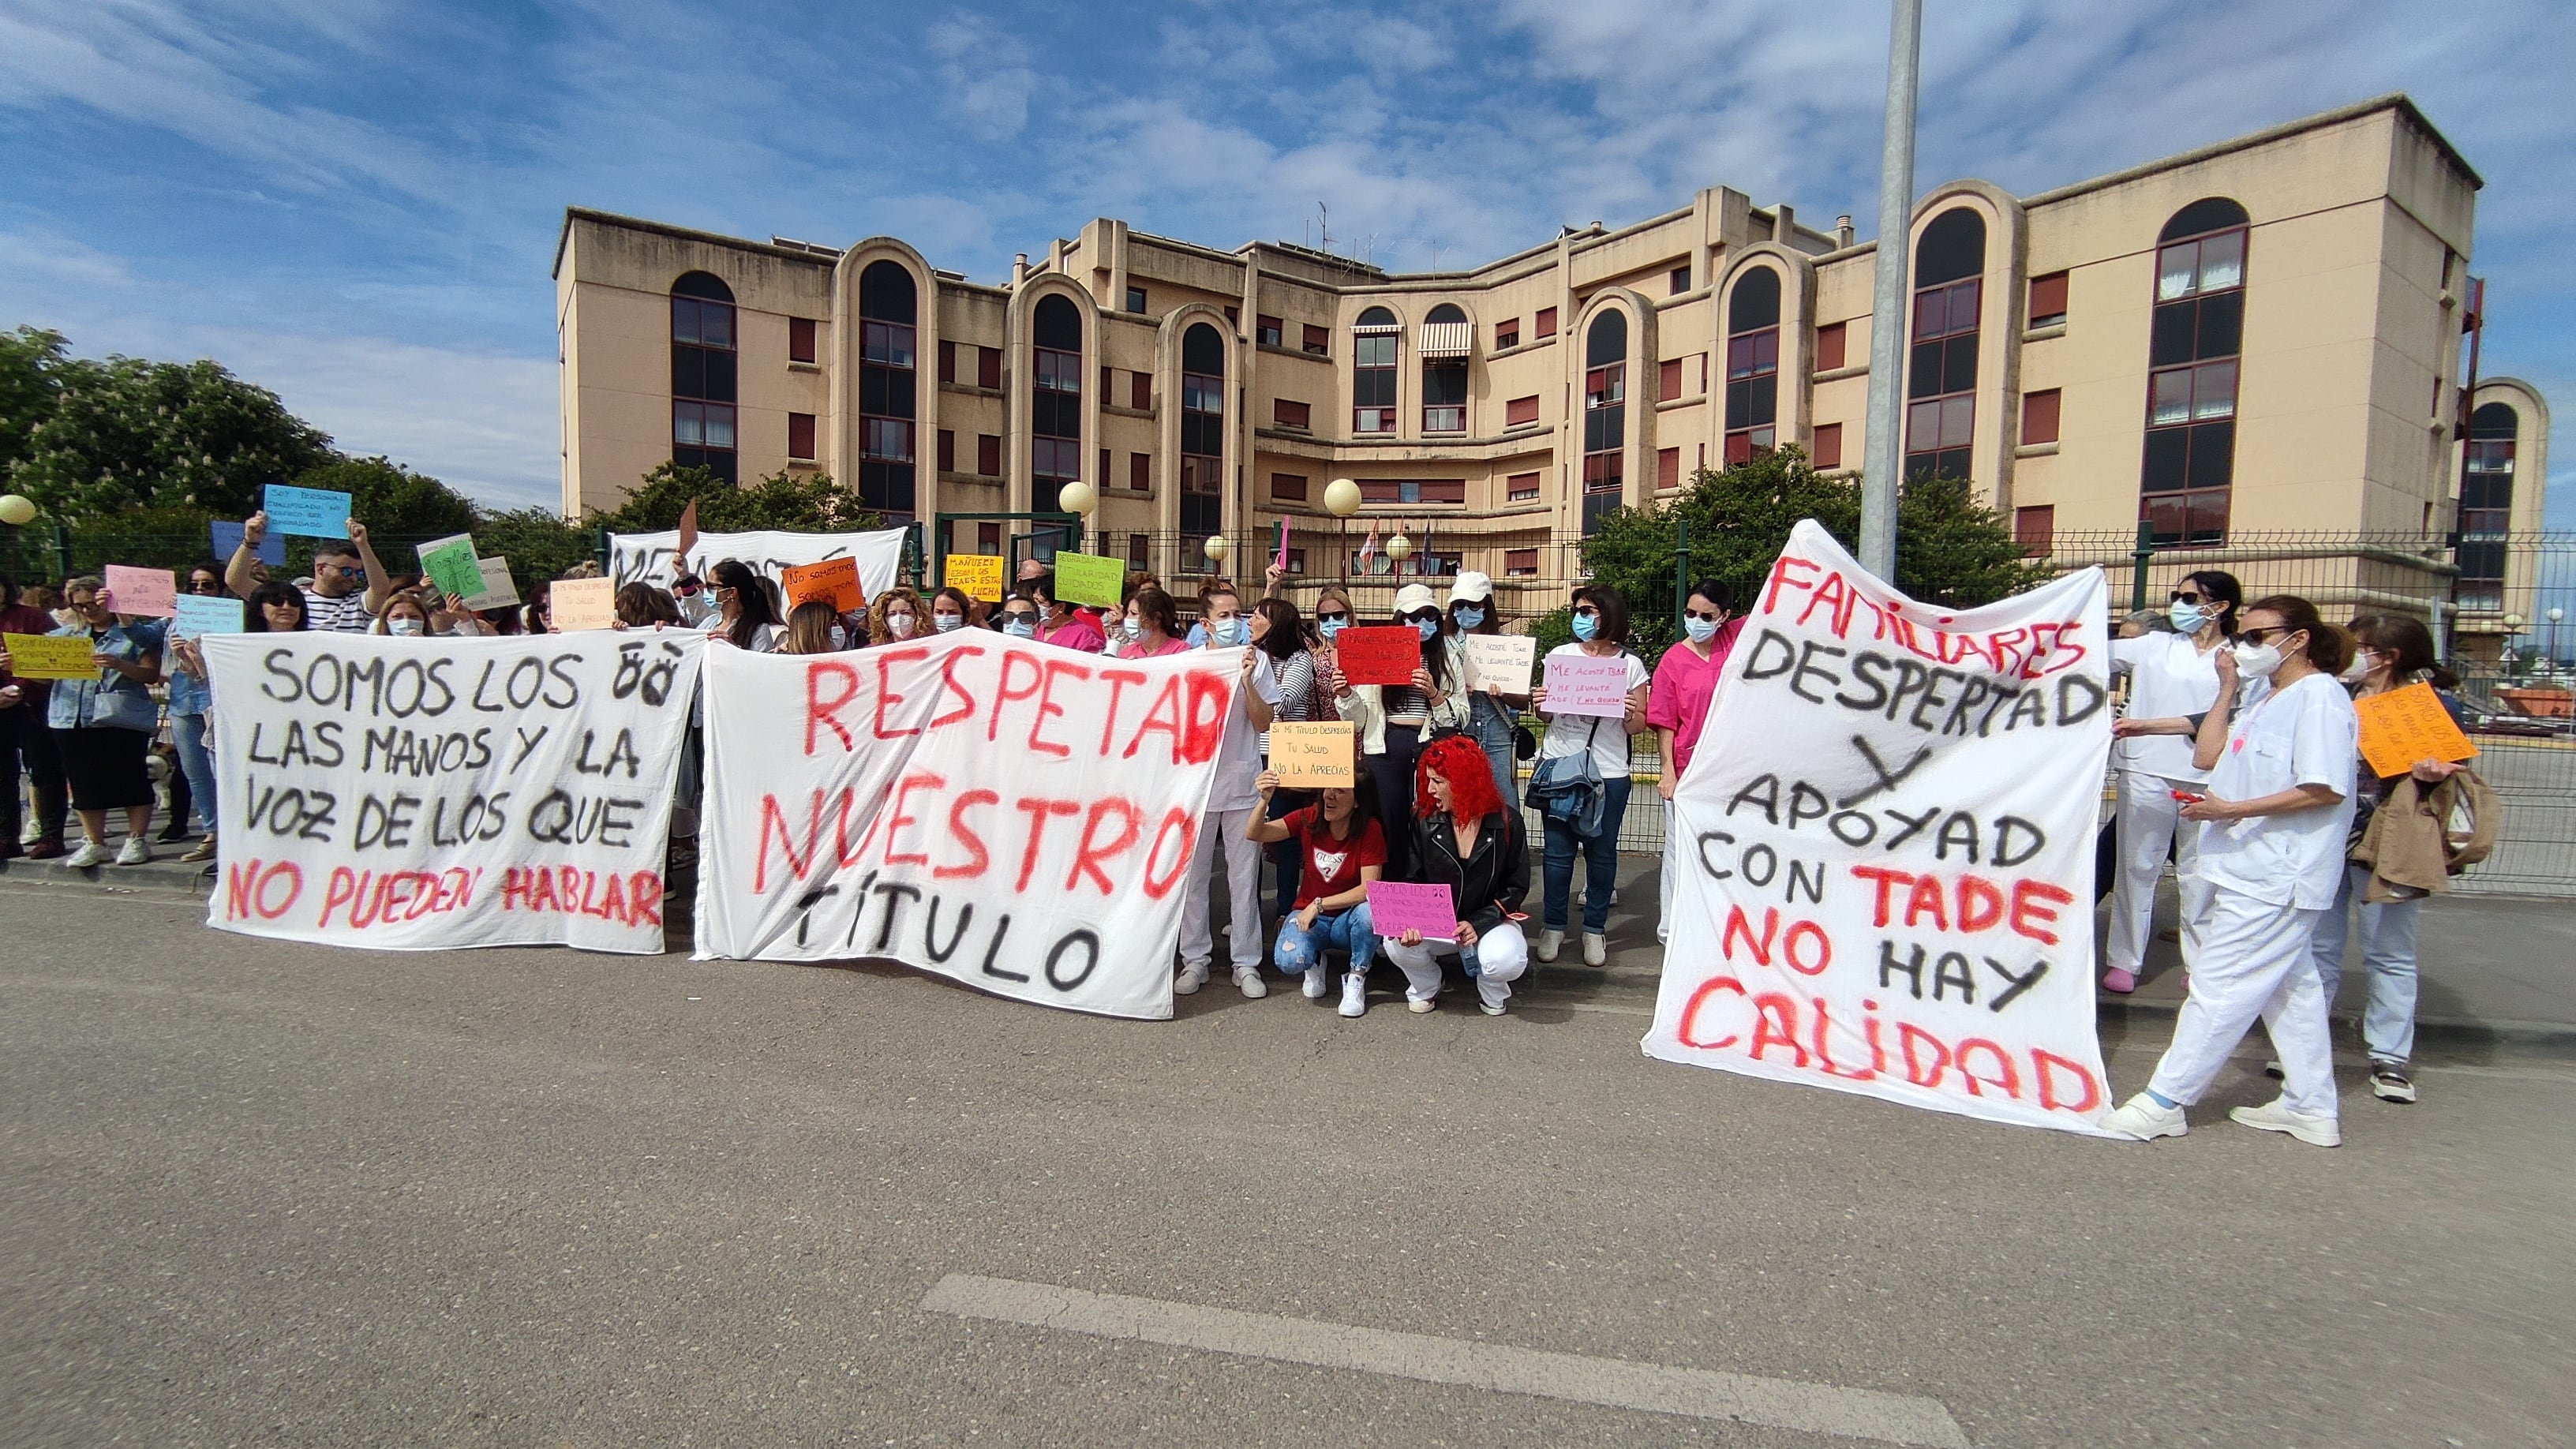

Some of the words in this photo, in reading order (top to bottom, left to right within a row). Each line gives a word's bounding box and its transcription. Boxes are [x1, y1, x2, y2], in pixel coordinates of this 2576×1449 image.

[1057, 553, 1097, 565] DEGRADAR
[971, 586, 1001, 597] LUCHA
[1057, 576, 1105, 591] CUIDADOS
[1057, 587, 1070, 598] SIN
[1073, 590, 1109, 604] CALIDAD
[1762, 555, 2087, 680] FAMILIARES
[1469, 639, 1480, 650] ME
[1485, 642, 1507, 651] ACOSTÉ
[1474, 654, 1484, 665] ME
[1487, 656, 1514, 665] LEVANTÉ
[1515, 658, 1530, 667] TADE
[1550, 663, 1571, 677] ME
[1575, 666, 1605, 676] ACOSTÉ
[261, 647, 457, 718] SOMOS
[474, 652, 585, 712] LOS
[1546, 682, 1552, 693] Y
[1575, 682, 1612, 692] LEVANTÉ
[1741, 628, 2106, 739] DESPERTAD
[803, 644, 1231, 766] RESPETAD
[1547, 695, 1567, 703] TADE
[249, 719, 345, 769] LAS
[361, 724, 492, 779] MANOS
[508, 724, 549, 776] Y
[575, 727, 642, 779] LA
[1286, 742, 1297, 753] TU
[1303, 743, 1329, 754] SALUD
[1274, 762, 1287, 775] NO
[1292, 762, 1303, 775] LA
[1836, 734, 1932, 810] Y
[245, 773, 338, 844] VOZ
[354, 792, 423, 853] DE
[432, 790, 512, 848] LOS
[527, 788, 646, 848] QUE
[1725, 773, 2046, 868] APOYAD
[751, 773, 1198, 900] NUESTRO
[1316, 852, 1346, 863] GUESS
[227, 858, 305, 924] NO
[318, 865, 484, 930] PUEDEN
[502, 863, 664, 930] HABLAR
[1369, 882, 1407, 895] SOMOS
[1410, 885, 1428, 898] LOS
[1697, 830, 1825, 904] CON
[1849, 864, 2076, 945] TADE
[1370, 896, 1384, 905] LAS
[1372, 908, 1384, 917] DE
[1411, 910, 1429, 919] QUE
[1443, 913, 1455, 922] NO
[796, 868, 1100, 993] TÍTULO
[1721, 903, 1833, 977] NO
[1878, 939, 2050, 1013] HAY
[1678, 975, 2100, 1114] CALIDAD
